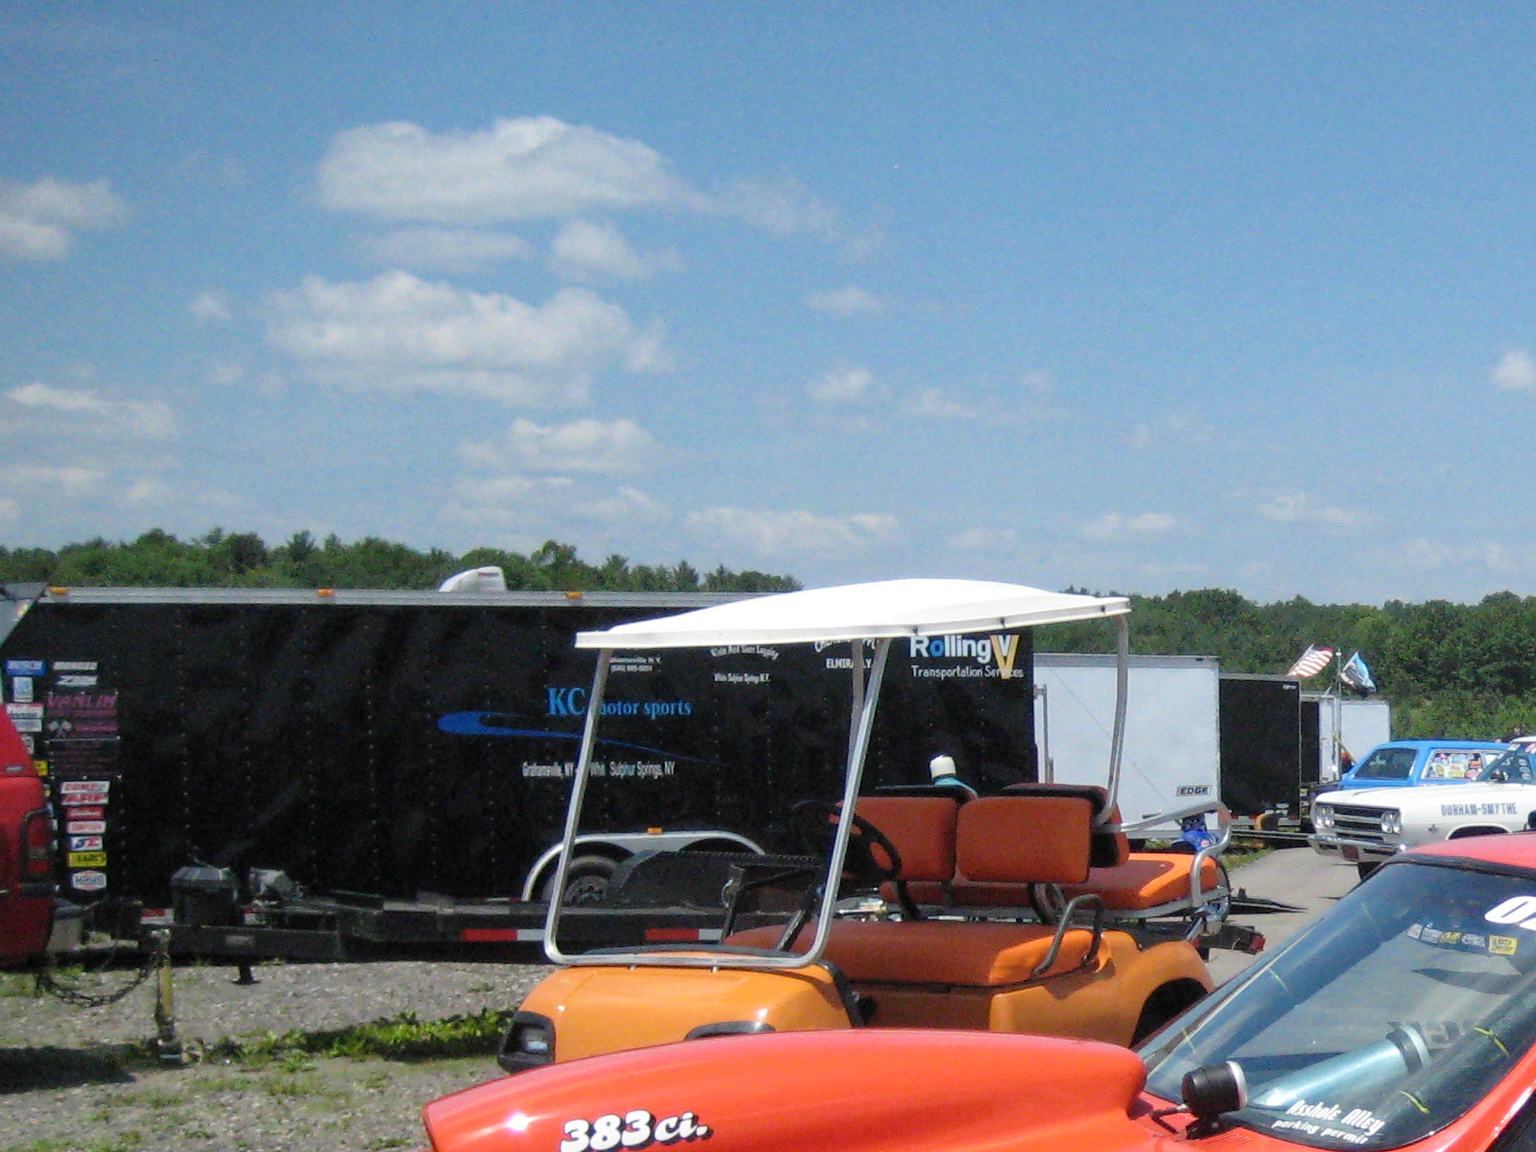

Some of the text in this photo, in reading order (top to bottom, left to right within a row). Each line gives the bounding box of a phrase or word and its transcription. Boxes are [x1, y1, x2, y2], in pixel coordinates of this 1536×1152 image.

[910, 634, 991, 664] Rolling
[911, 665, 983, 680] Transportation
[547, 687, 587, 716] KC
[643, 699, 692, 721] sports
[664, 761, 676, 775] NY
[1180, 786, 1208, 795] EDGE
[1286, 1099, 1386, 1137] Asshole Alley
[1271, 1119, 1369, 1145] parking permit
